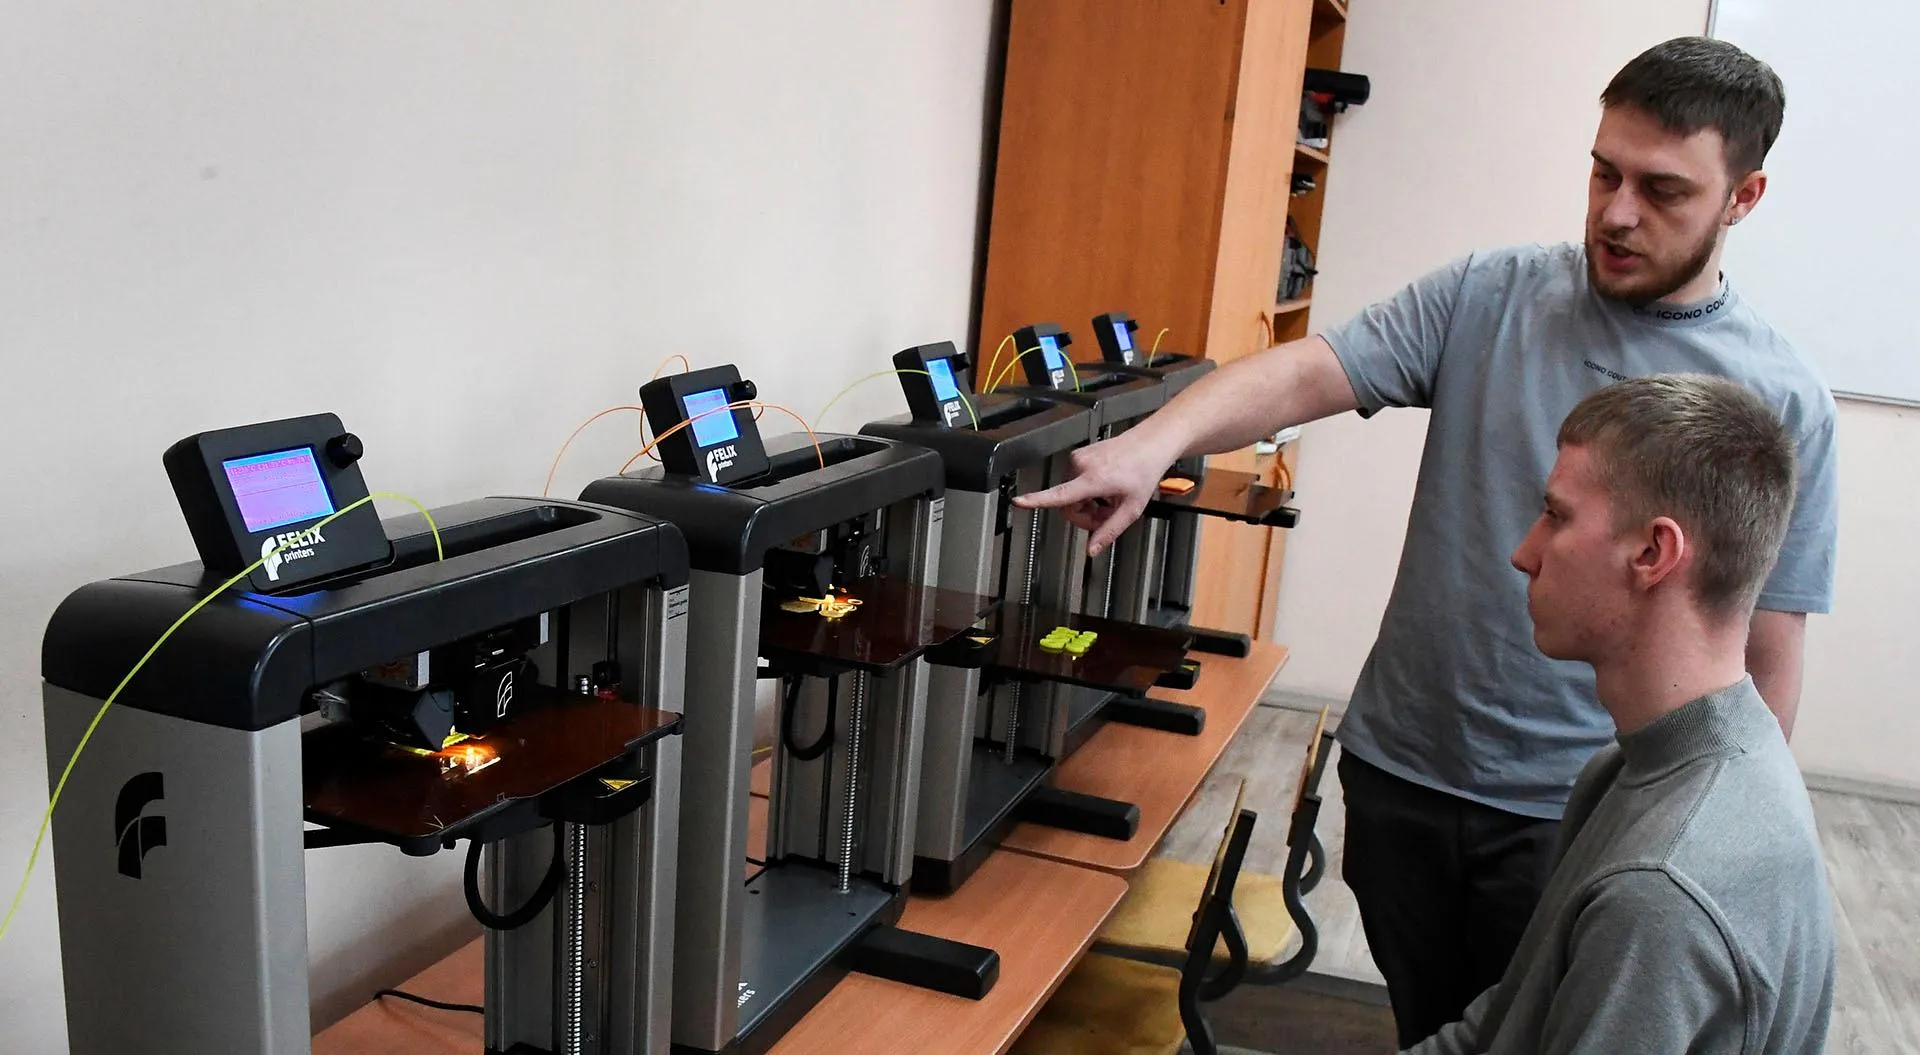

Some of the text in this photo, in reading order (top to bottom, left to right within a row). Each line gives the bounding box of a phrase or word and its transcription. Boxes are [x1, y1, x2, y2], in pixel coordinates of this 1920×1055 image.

[1656, 309, 1702, 321] ICONO
[1607, 370, 1627, 381] COUT
[713, 444, 738, 462] FELIX
[276, 526, 326, 550] FELIX
[284, 548, 315, 564] printers
